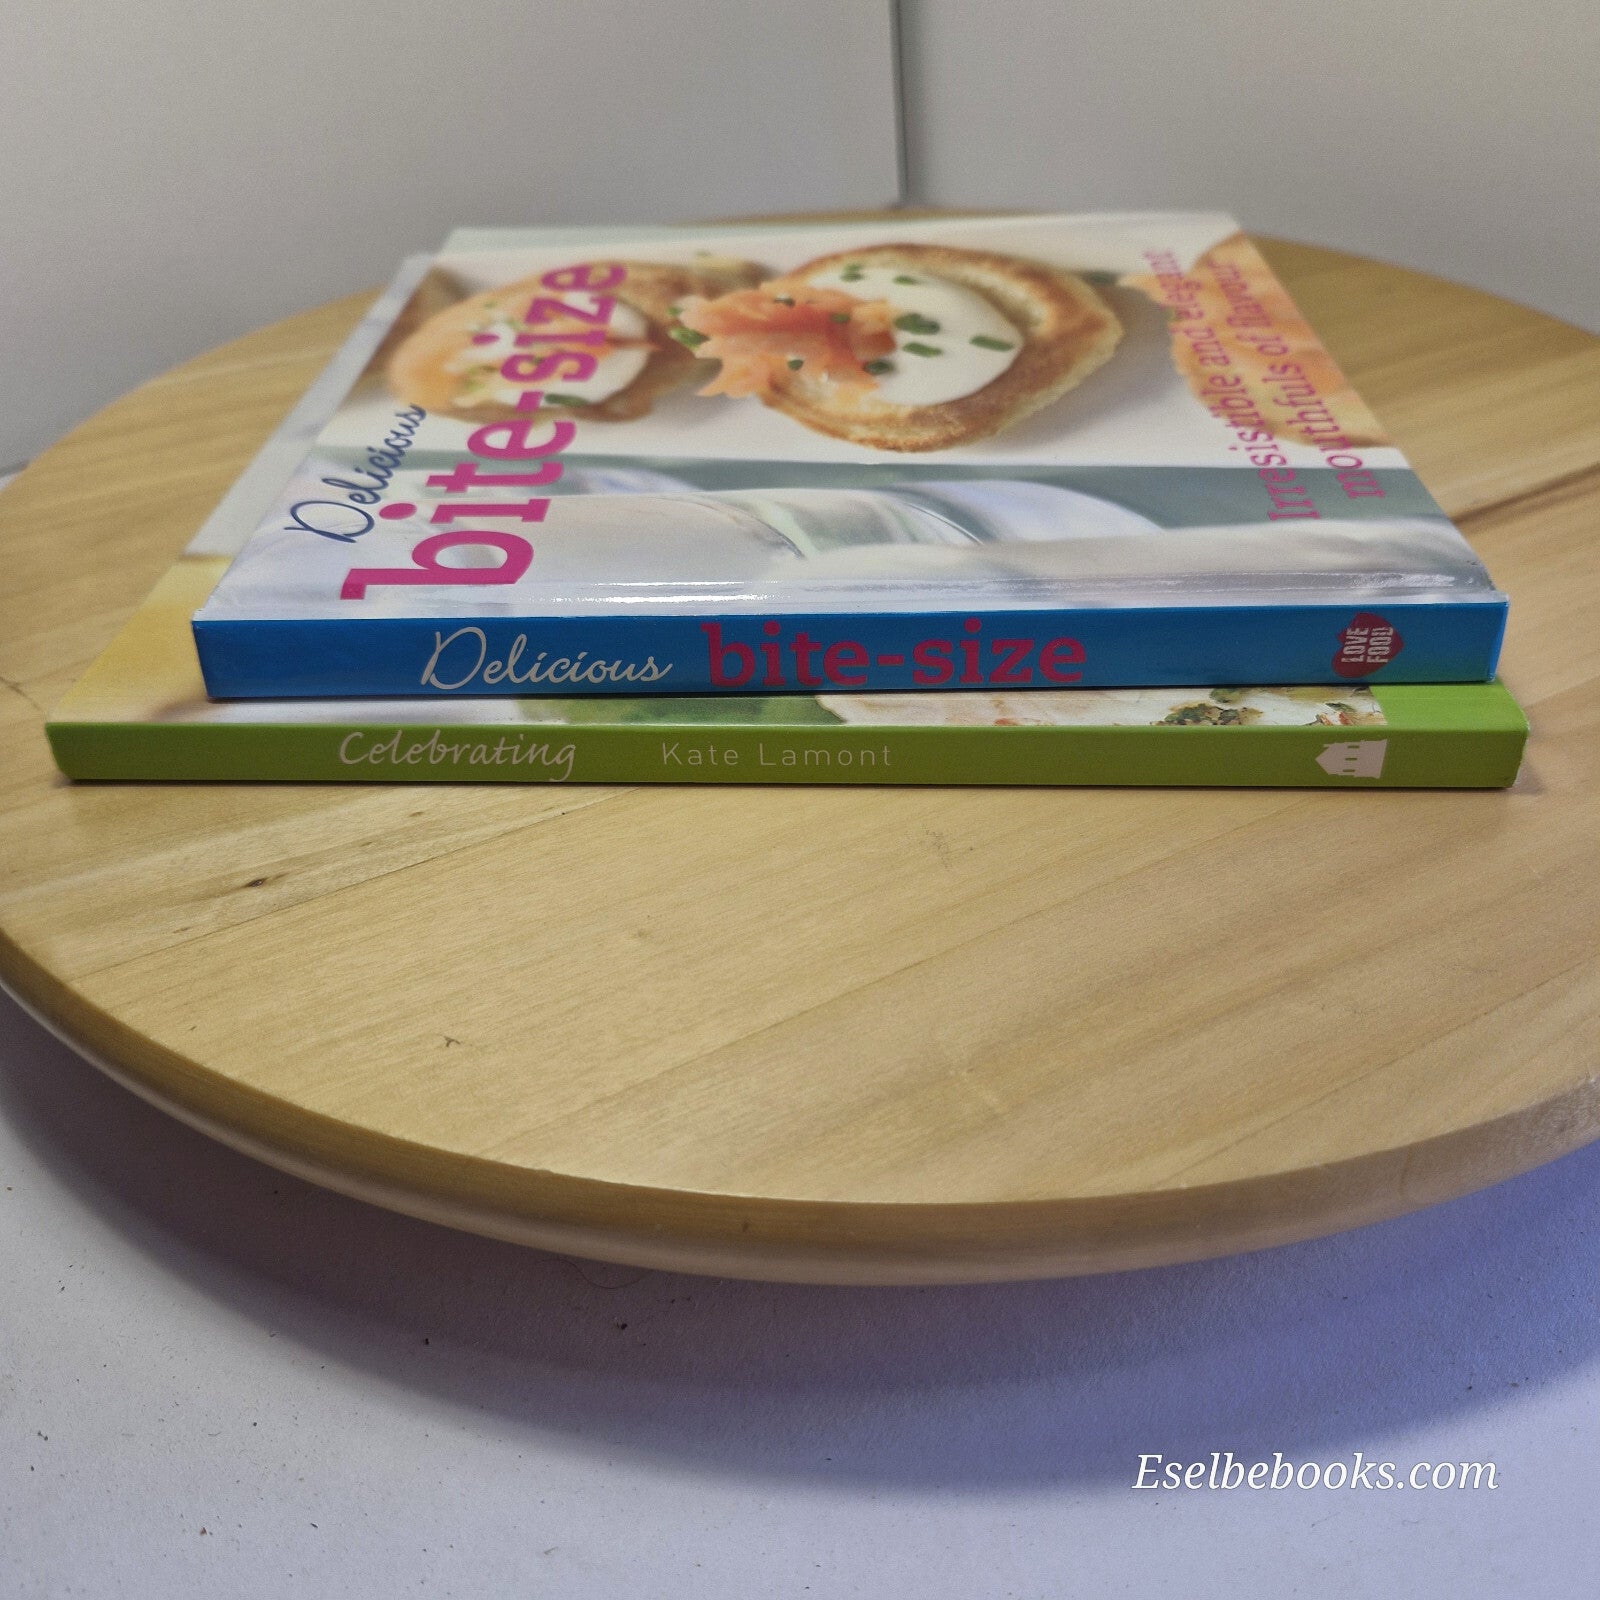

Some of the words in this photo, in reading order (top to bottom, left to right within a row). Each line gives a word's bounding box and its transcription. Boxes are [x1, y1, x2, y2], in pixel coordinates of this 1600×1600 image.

[1168, 327, 1231, 366] and
[1236, 332, 1289, 357] of
[340, 263, 627, 600] bite-size
[1201, 375, 1320, 521] Irresistible
[1260, 362, 1386, 500] mouthfuls
[284, 404, 427, 543] Delicious
[420, 626, 674, 690] Delicious
[700, 617, 1087, 687] bite-size
[1341, 627, 1369, 663] LOVE
[1366, 626, 1394, 663] FOOD
[338, 729, 577, 782] Celebrating
[662, 743, 739, 766] Kate
[758, 743, 891, 767] Lamont
